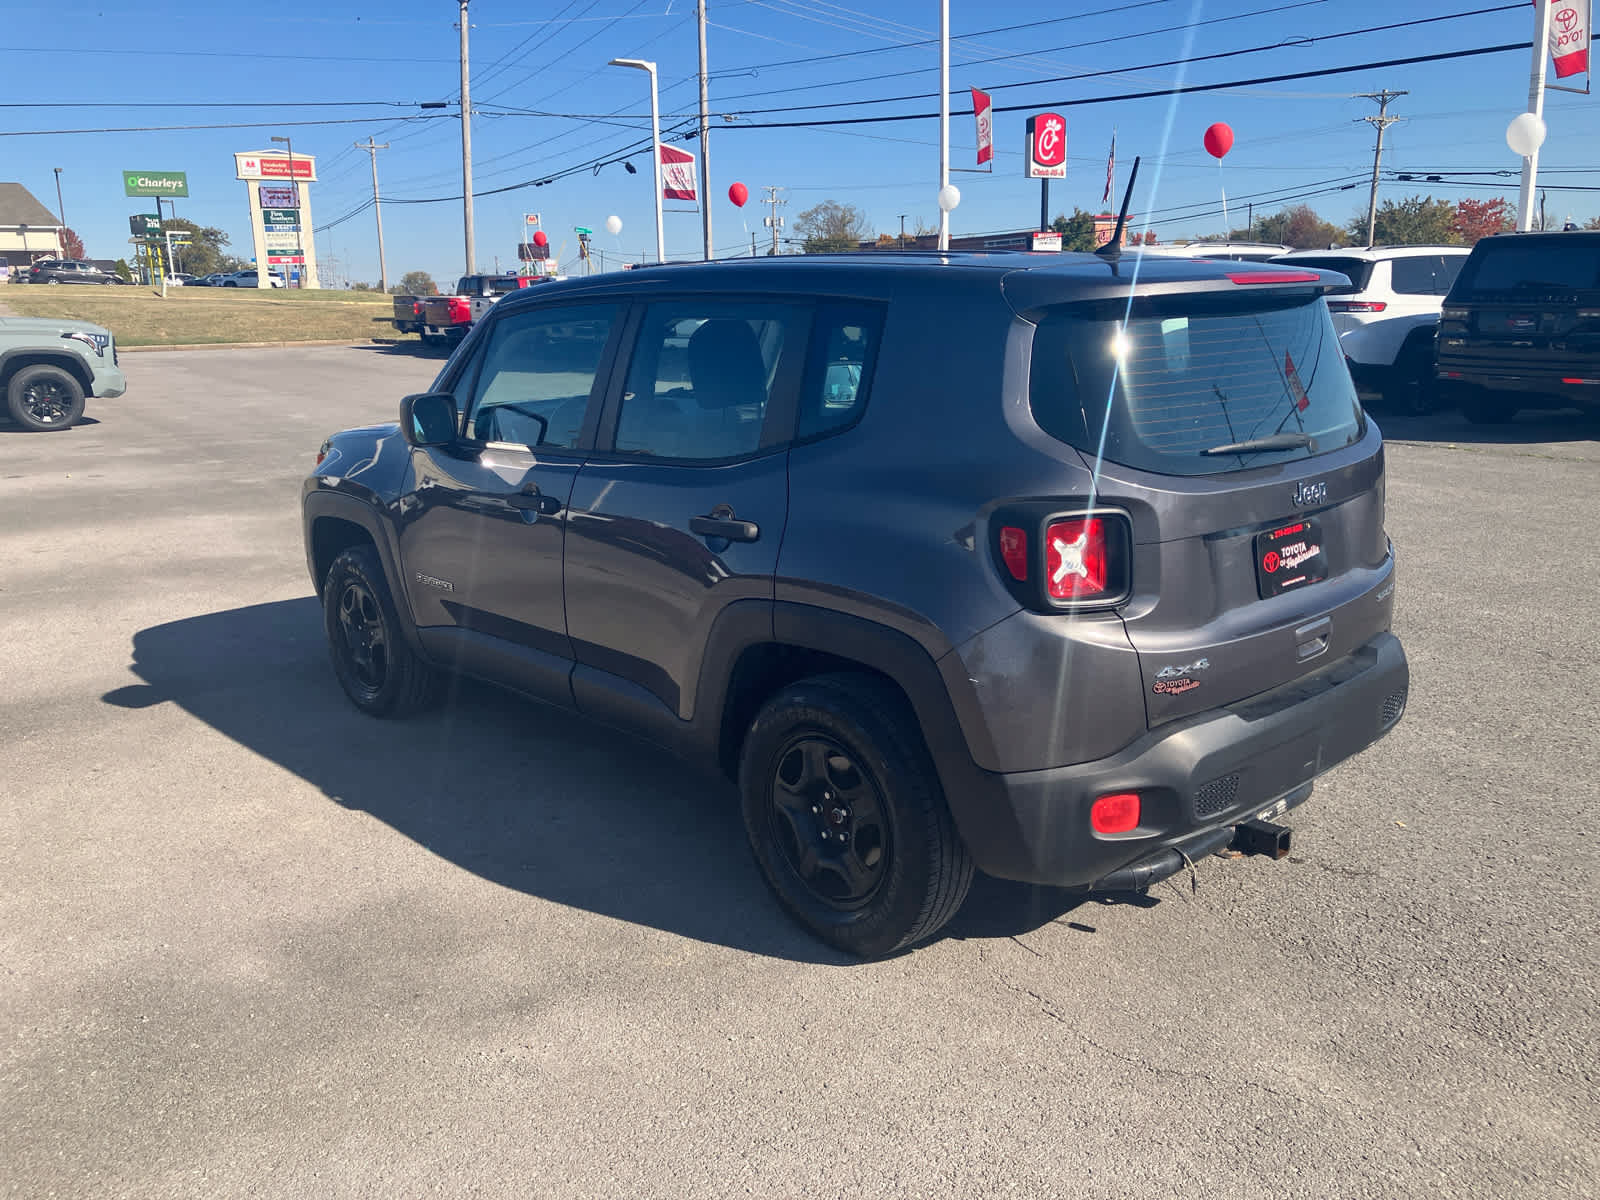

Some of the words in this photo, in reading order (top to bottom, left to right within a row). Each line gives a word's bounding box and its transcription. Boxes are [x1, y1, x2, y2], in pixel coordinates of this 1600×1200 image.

[1293, 482, 1327, 505] Jeep
[1281, 541, 1307, 558] TOYOTA
[1166, 678, 1190, 688] TOYOTA
